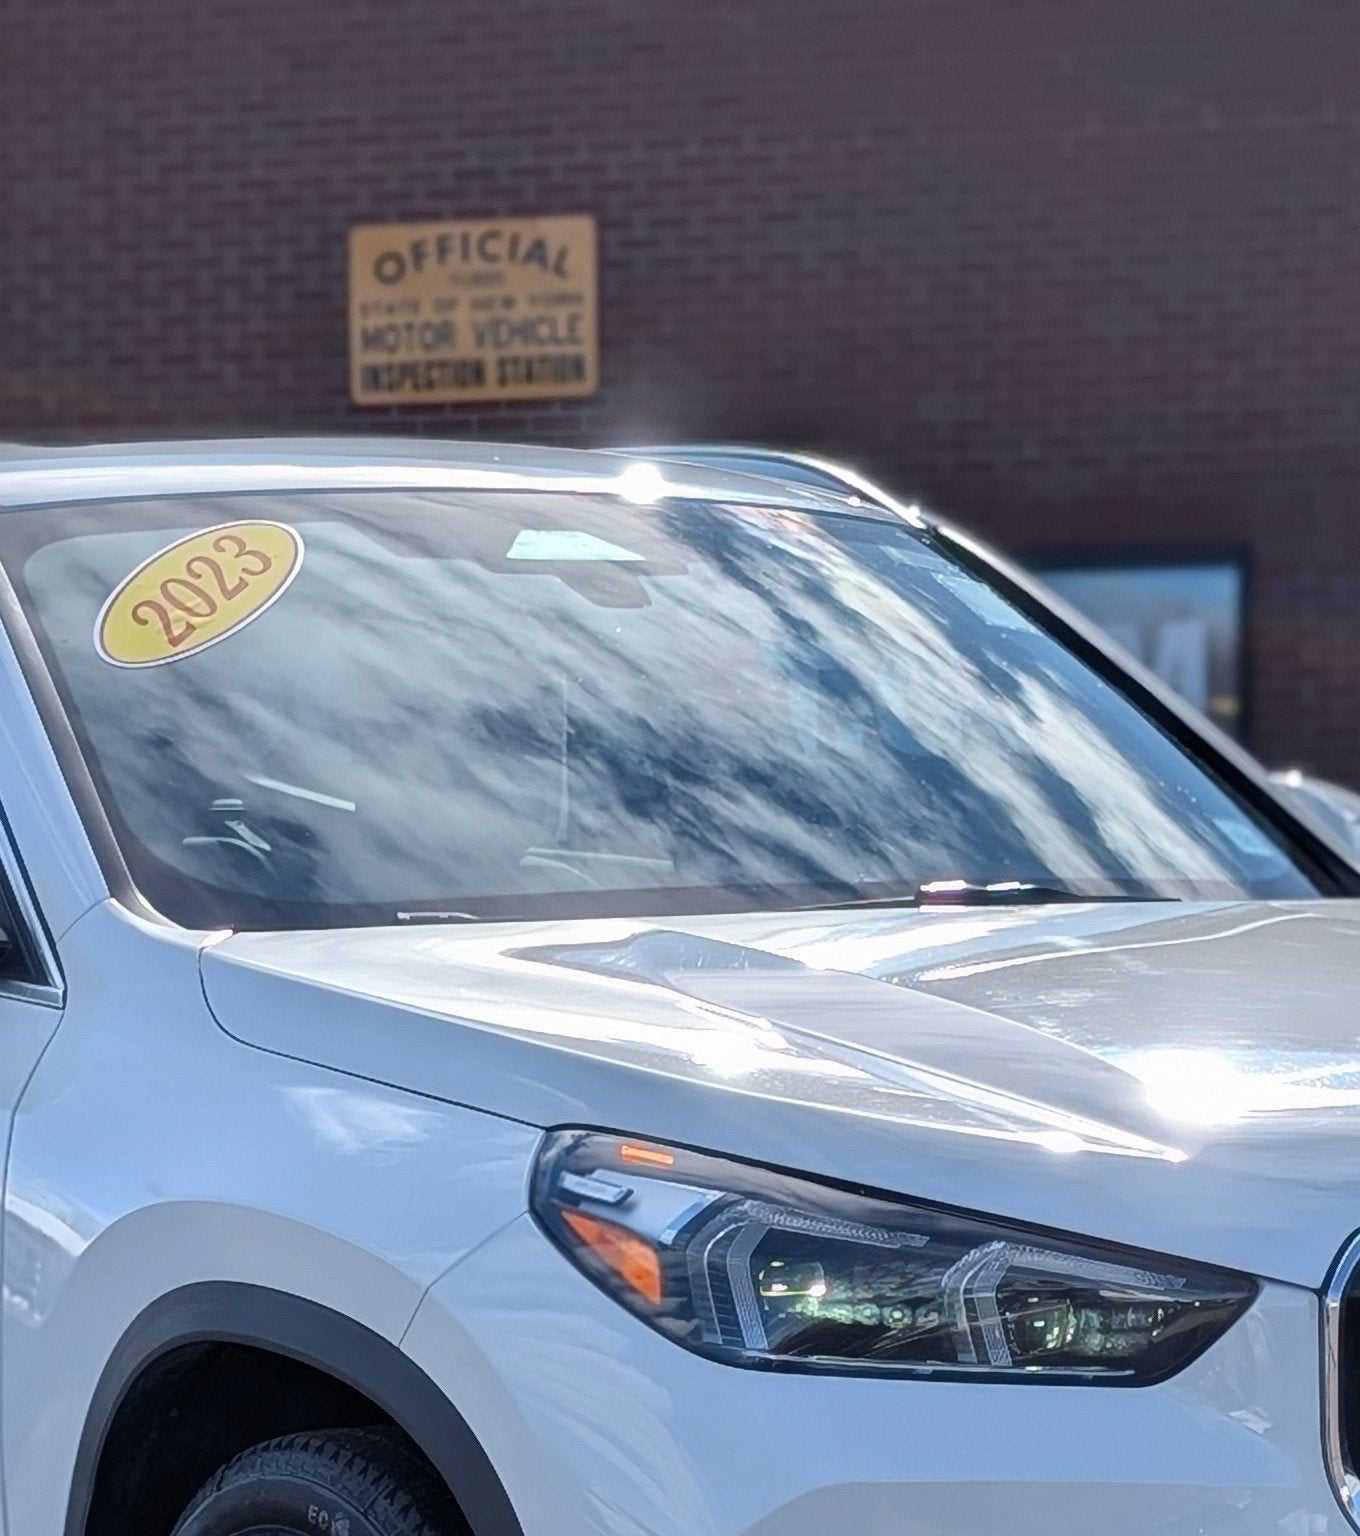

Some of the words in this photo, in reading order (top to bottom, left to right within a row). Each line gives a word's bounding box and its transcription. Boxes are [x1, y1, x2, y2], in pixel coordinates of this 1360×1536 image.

[373, 229, 569, 285] OFFICIAL
[359, 319, 455, 352] MOTOR
[471, 313, 582, 350] VEHICLE
[131, 534, 273, 648] 2023
